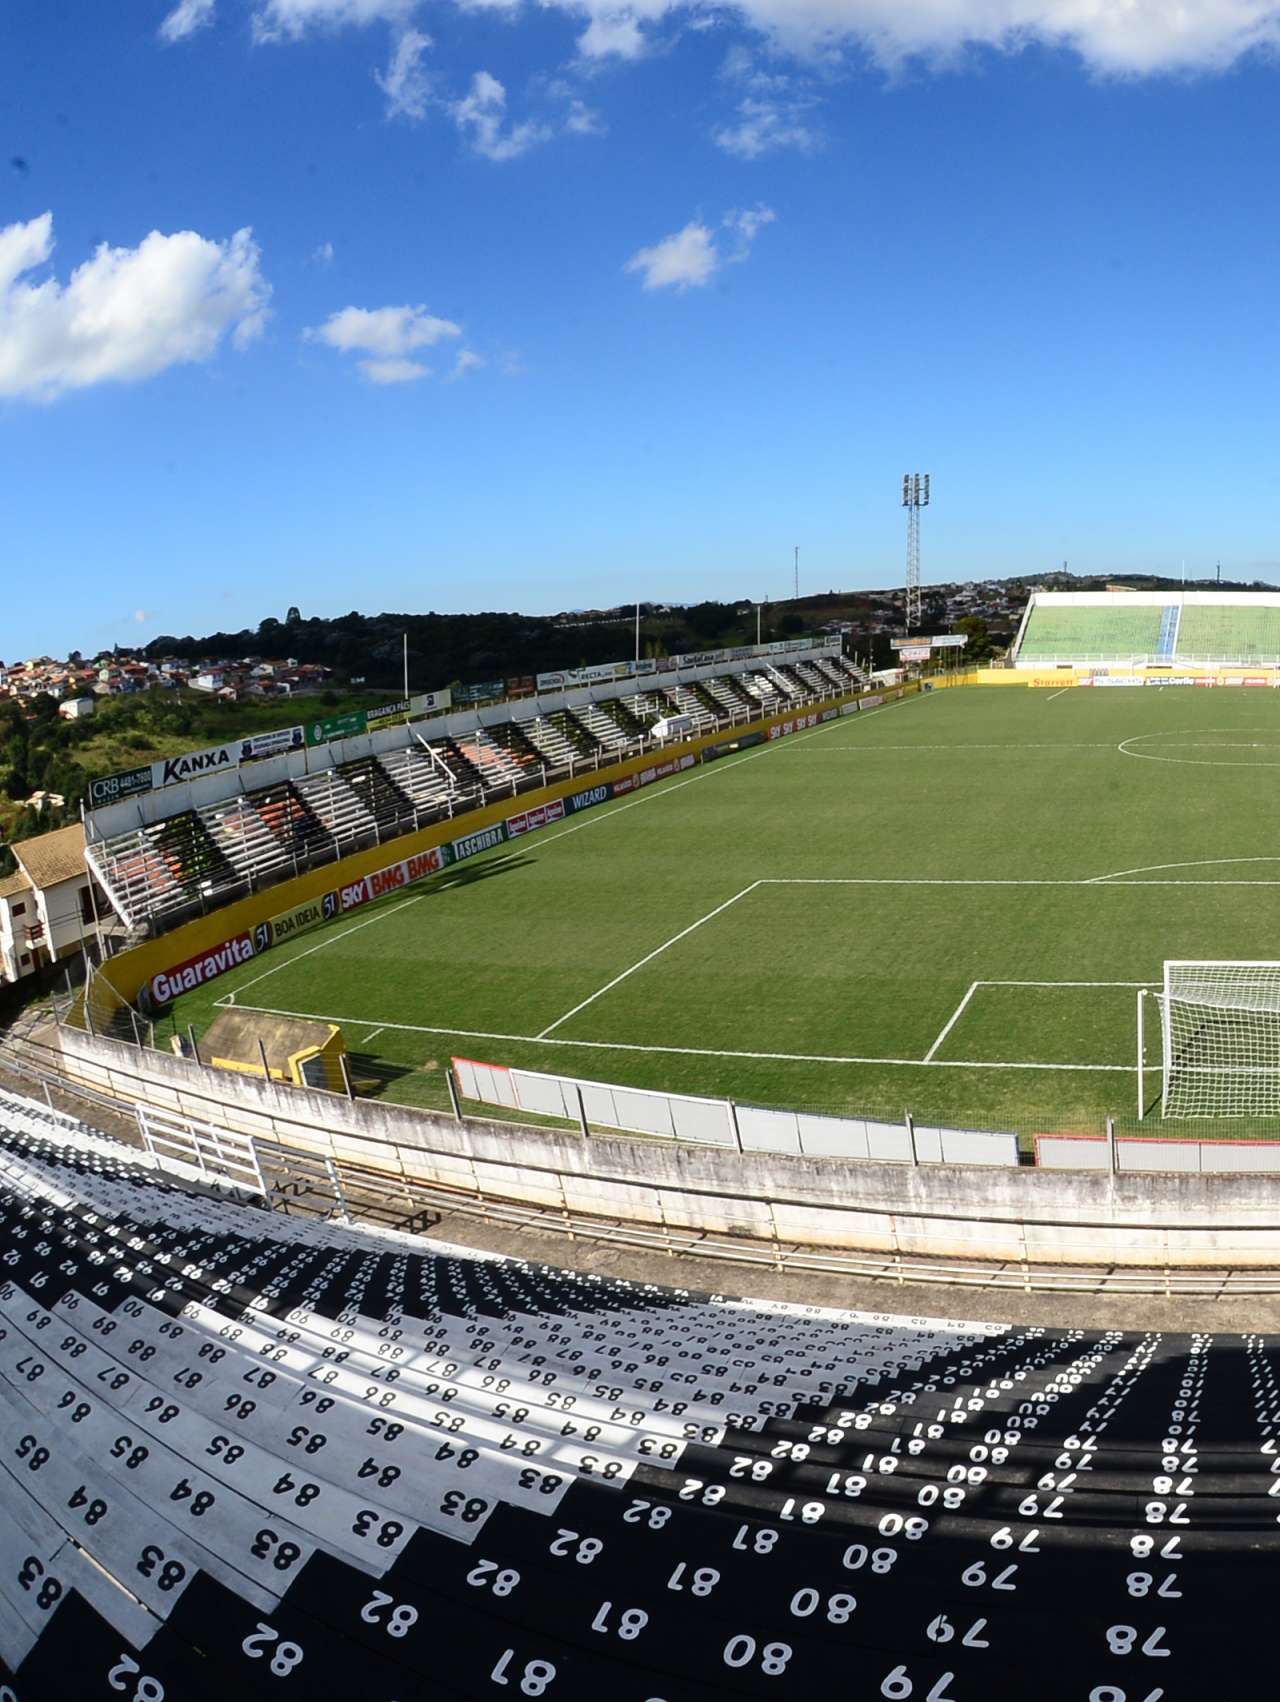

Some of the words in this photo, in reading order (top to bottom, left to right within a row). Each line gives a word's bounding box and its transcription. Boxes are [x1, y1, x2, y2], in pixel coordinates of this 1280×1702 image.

[163, 750, 229, 784] KANXA
[93, 778, 120, 798] CRB
[572, 786, 607, 810] WIZARD
[452, 828, 504, 861] TASCHIBRA
[372, 867, 404, 896] BMG
[407, 850, 441, 881] BMG
[342, 882, 366, 909] SKY
[256, 926, 270, 950] 51
[275, 919, 295, 938] BOA
[295, 908, 321, 931] IDEIA
[323, 893, 336, 918] 51
[152, 936, 254, 1004] Guaravita
[60, 1333, 91, 1357] 88
[16, 1357, 44, 1381] 87
[98, 1362, 133, 1389] 87
[174, 1368, 202, 1388] 87
[224, 1394, 256, 1419] 86
[300, 1392, 334, 1413] 86
[364, 1385, 396, 1406] 86
[145, 1397, 179, 1423] 86
[491, 1405, 528, 1423] 85
[838, 1412, 872, 1429] 82
[367, 1418, 403, 1441] 85
[429, 1413, 464, 1434] 85
[561, 1423, 600, 1441] 84
[809, 1427, 844, 1443] 82
[914, 1423, 943, 1438] 81
[15, 1435, 49, 1471] 85
[110, 1436, 148, 1469] 85
[206, 1436, 244, 1464] 85
[287, 1427, 326, 1453] 85
[1162, 1439, 1197, 1453] 78
[435, 1443, 479, 1468] 84
[580, 1454, 624, 1480] 83
[863, 1454, 898, 1473] 81
[970, 1446, 1008, 1463] 80
[1056, 1453, 1091, 1468] 79
[1162, 1456, 1197, 1471] 78
[358, 1458, 400, 1487] 84
[519, 1469, 562, 1494] 83
[730, 1457, 772, 1480] 82
[170, 1479, 214, 1516] 84
[273, 1473, 320, 1506] 84
[680, 1479, 725, 1504] 82
[919, 1485, 965, 1508] 80
[68, 1486, 107, 1525] 84
[440, 1491, 487, 1522] 83
[624, 1500, 671, 1529] 82
[781, 1499, 825, 1522] 81
[1019, 1495, 1064, 1517] 79
[1146, 1502, 1189, 1523] 78
[353, 1511, 403, 1547] 83
[733, 1525, 778, 1553] 81
[878, 1514, 929, 1540] 80
[991, 1527, 1039, 1551] 79
[251, 1530, 300, 1570] 83
[550, 1529, 603, 1564] 82
[843, 1545, 897, 1573] 80
[1131, 1535, 1181, 1558] 78
[137, 1546, 185, 1591] 83
[467, 1559, 520, 1596] 82
[668, 1563, 720, 1596] 81
[962, 1561, 1017, 1590] 79
[18, 1557, 62, 1609] 83
[1127, 1572, 1182, 1597] 78
[361, 1590, 418, 1637] 82
[791, 1588, 856, 1623] 80
[592, 1601, 649, 1640] 81
[927, 1615, 989, 1647] 79
[242, 1623, 303, 1676] 82
[1106, 1625, 1170, 1656] 78
[724, 1635, 792, 1675] 80
[491, 1649, 556, 1696] 81
